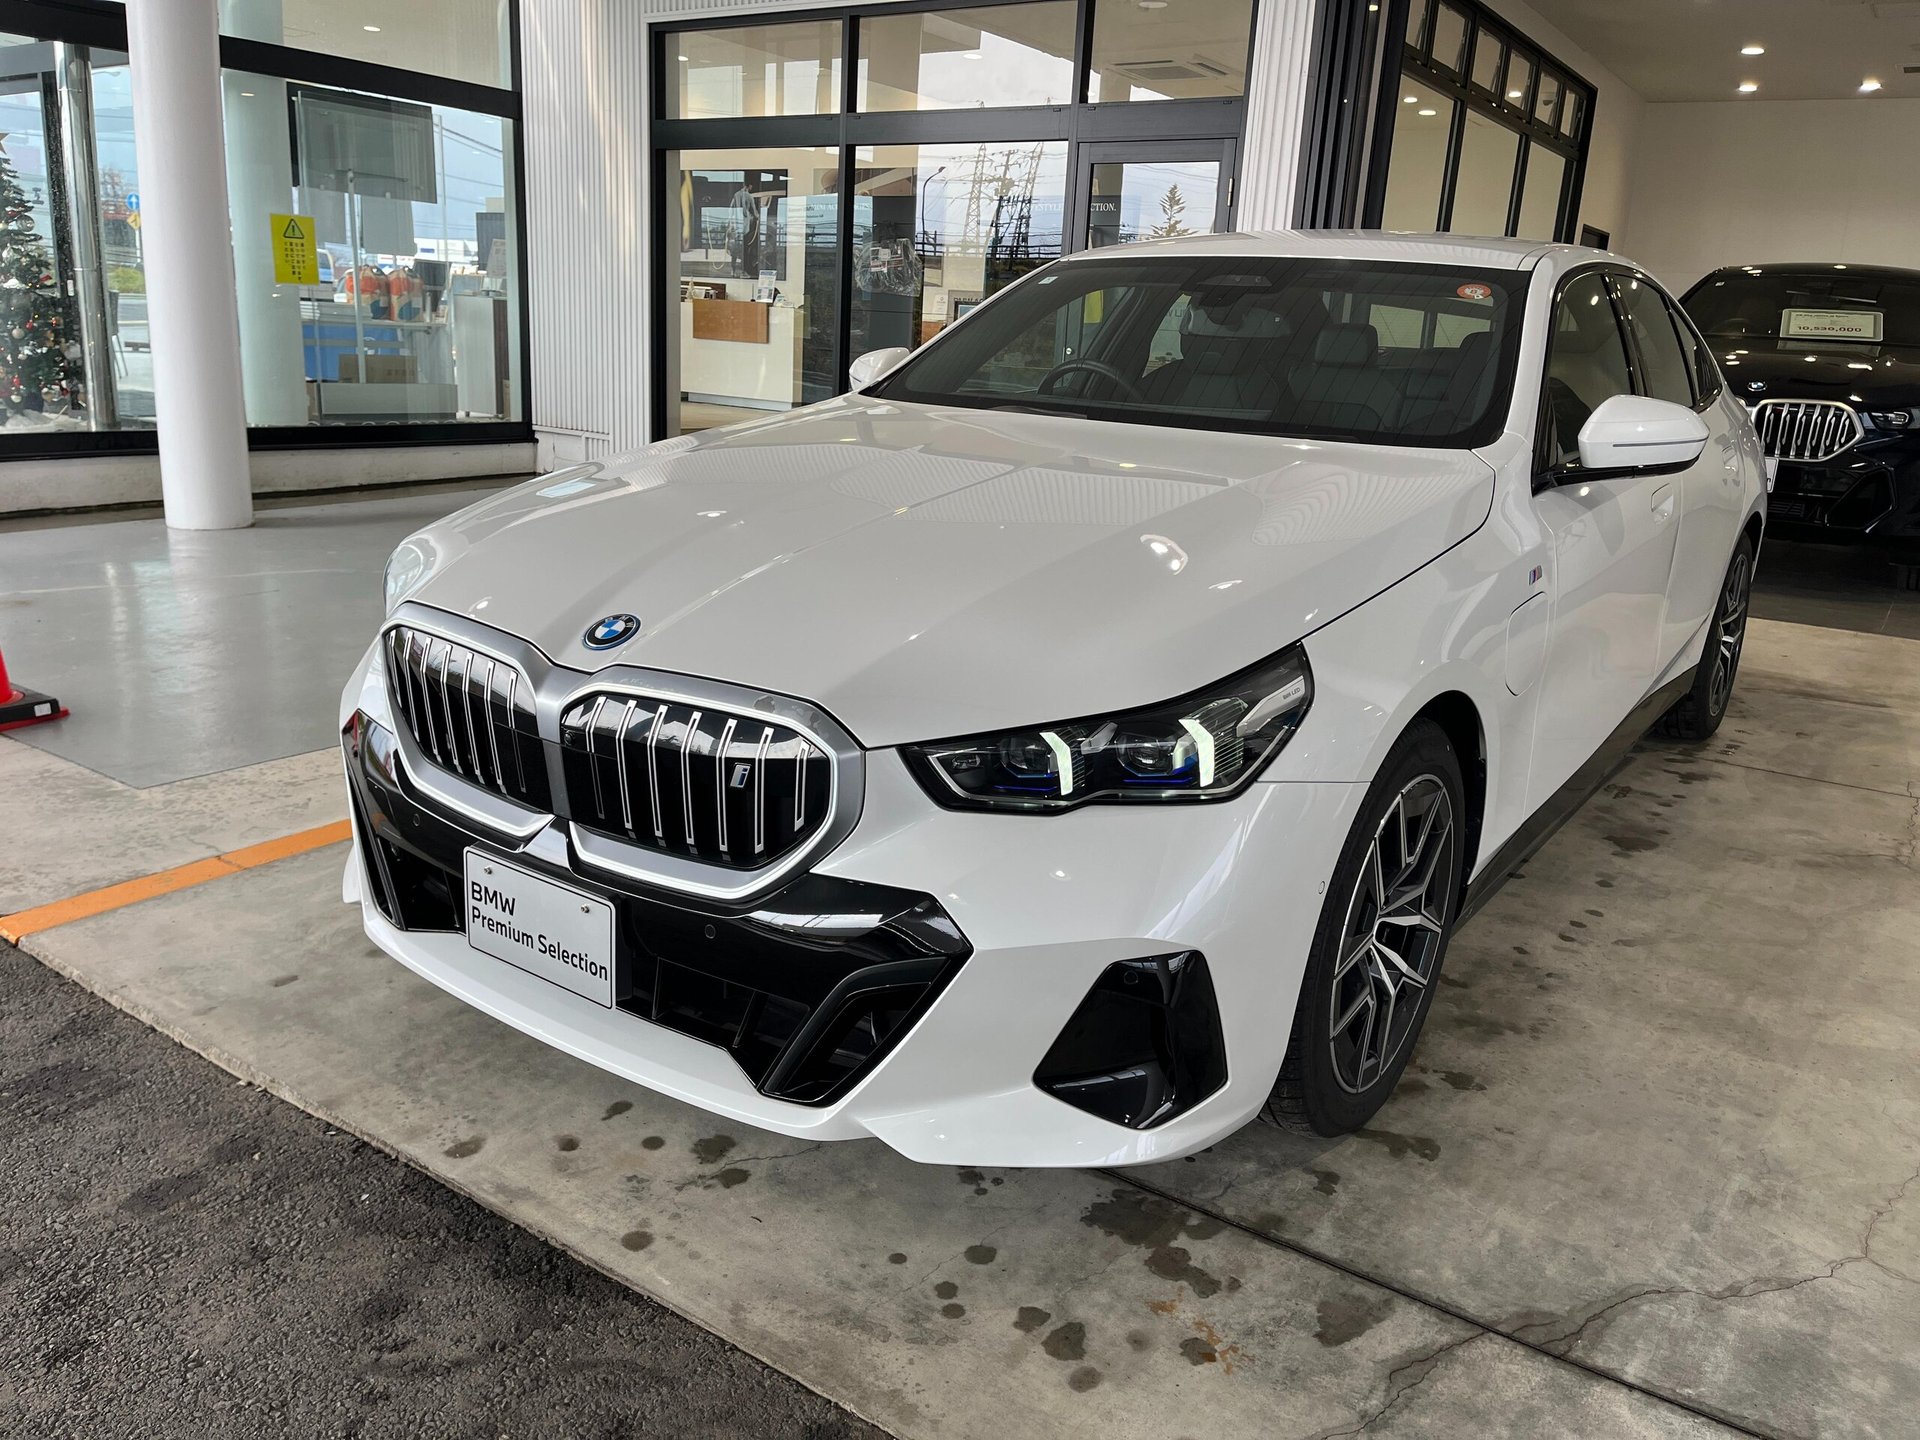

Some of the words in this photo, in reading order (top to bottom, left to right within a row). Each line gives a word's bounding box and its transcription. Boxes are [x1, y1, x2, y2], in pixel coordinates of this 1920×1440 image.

[471, 881, 515, 916] BMW
[472, 905, 534, 949] Premium
[537, 933, 608, 981] Selection
